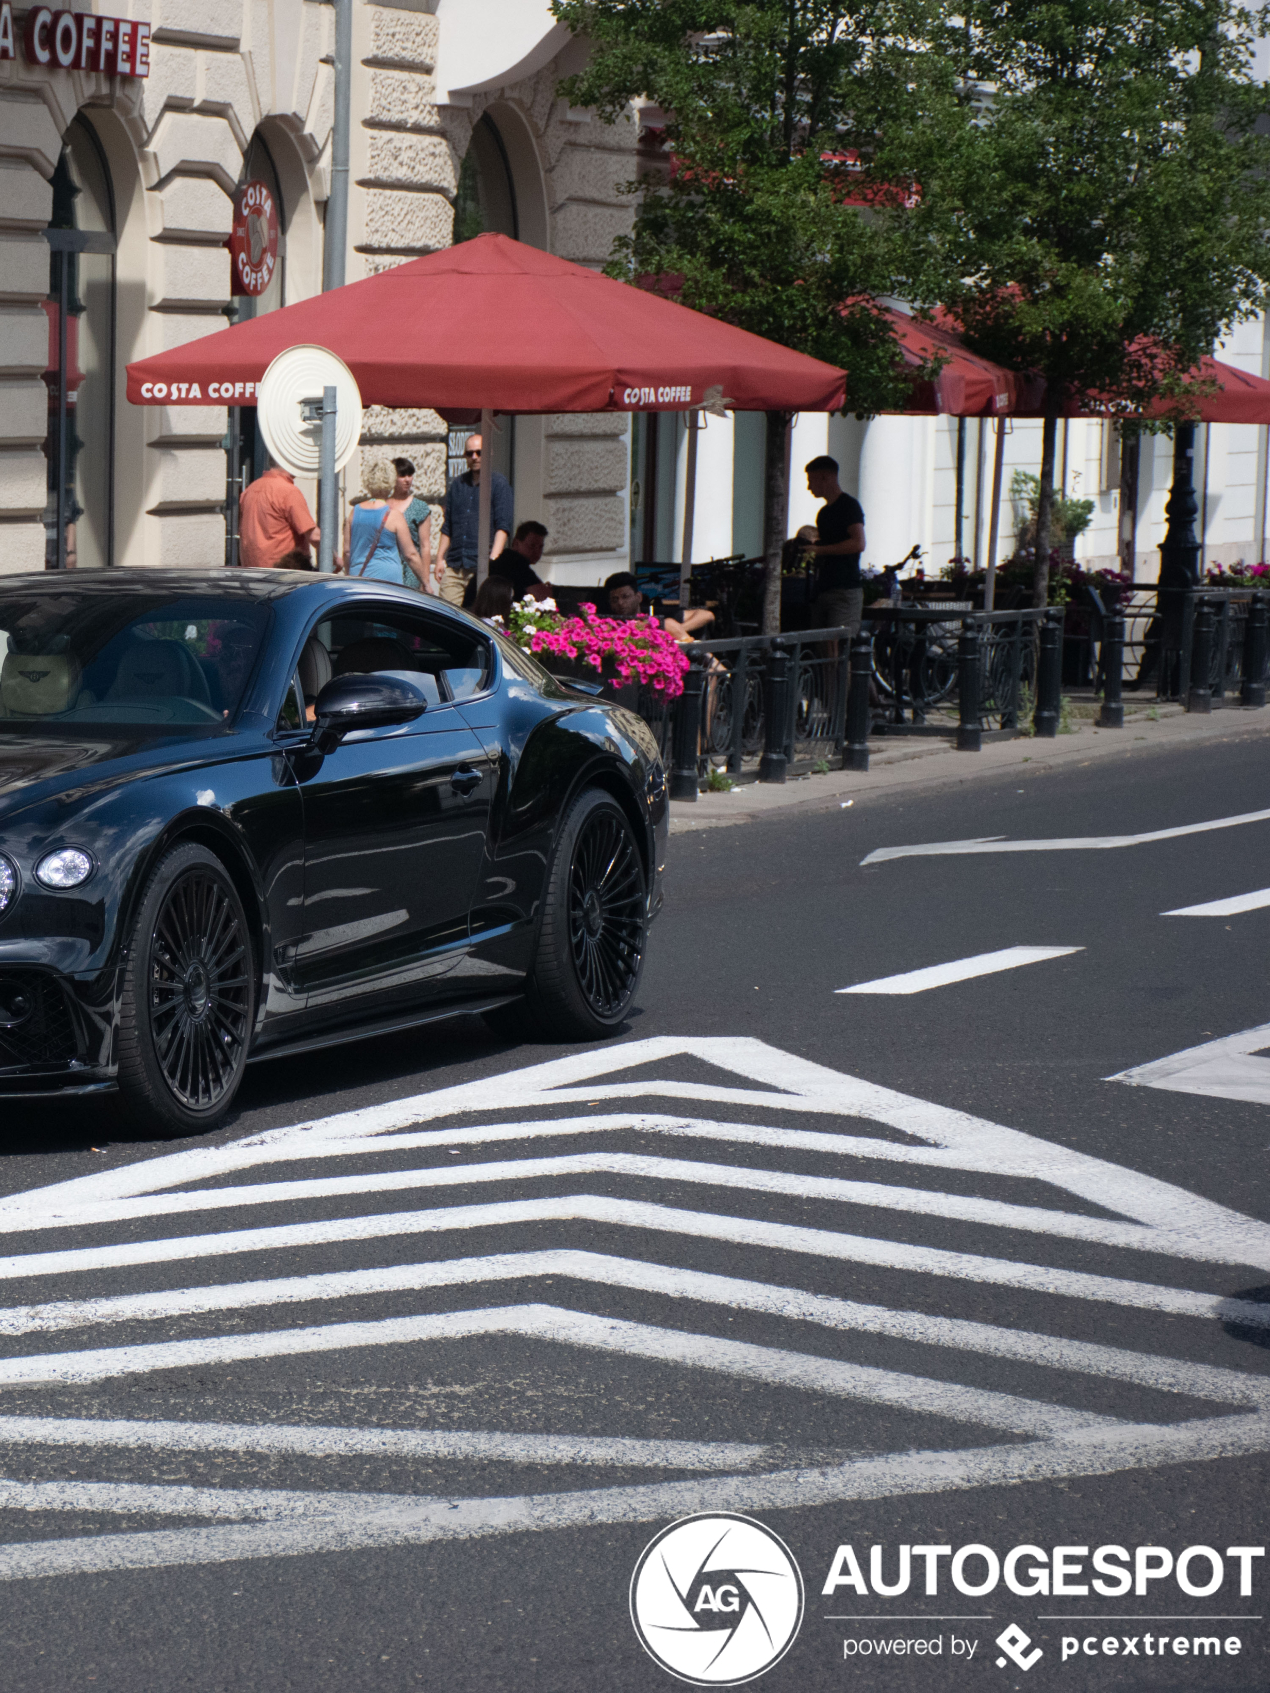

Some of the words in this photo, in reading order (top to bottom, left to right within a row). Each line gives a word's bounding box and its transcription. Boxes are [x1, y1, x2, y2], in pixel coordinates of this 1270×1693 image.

[33, 8, 151, 76] COFFEE
[241, 184, 272, 218] COSTA
[238, 251, 274, 291] COFFEE
[140, 382, 202, 401] COSTA
[208, 382, 261, 399] COFF
[623, 386, 656, 406] COSTA
[657, 385, 692, 403] COFFEE
